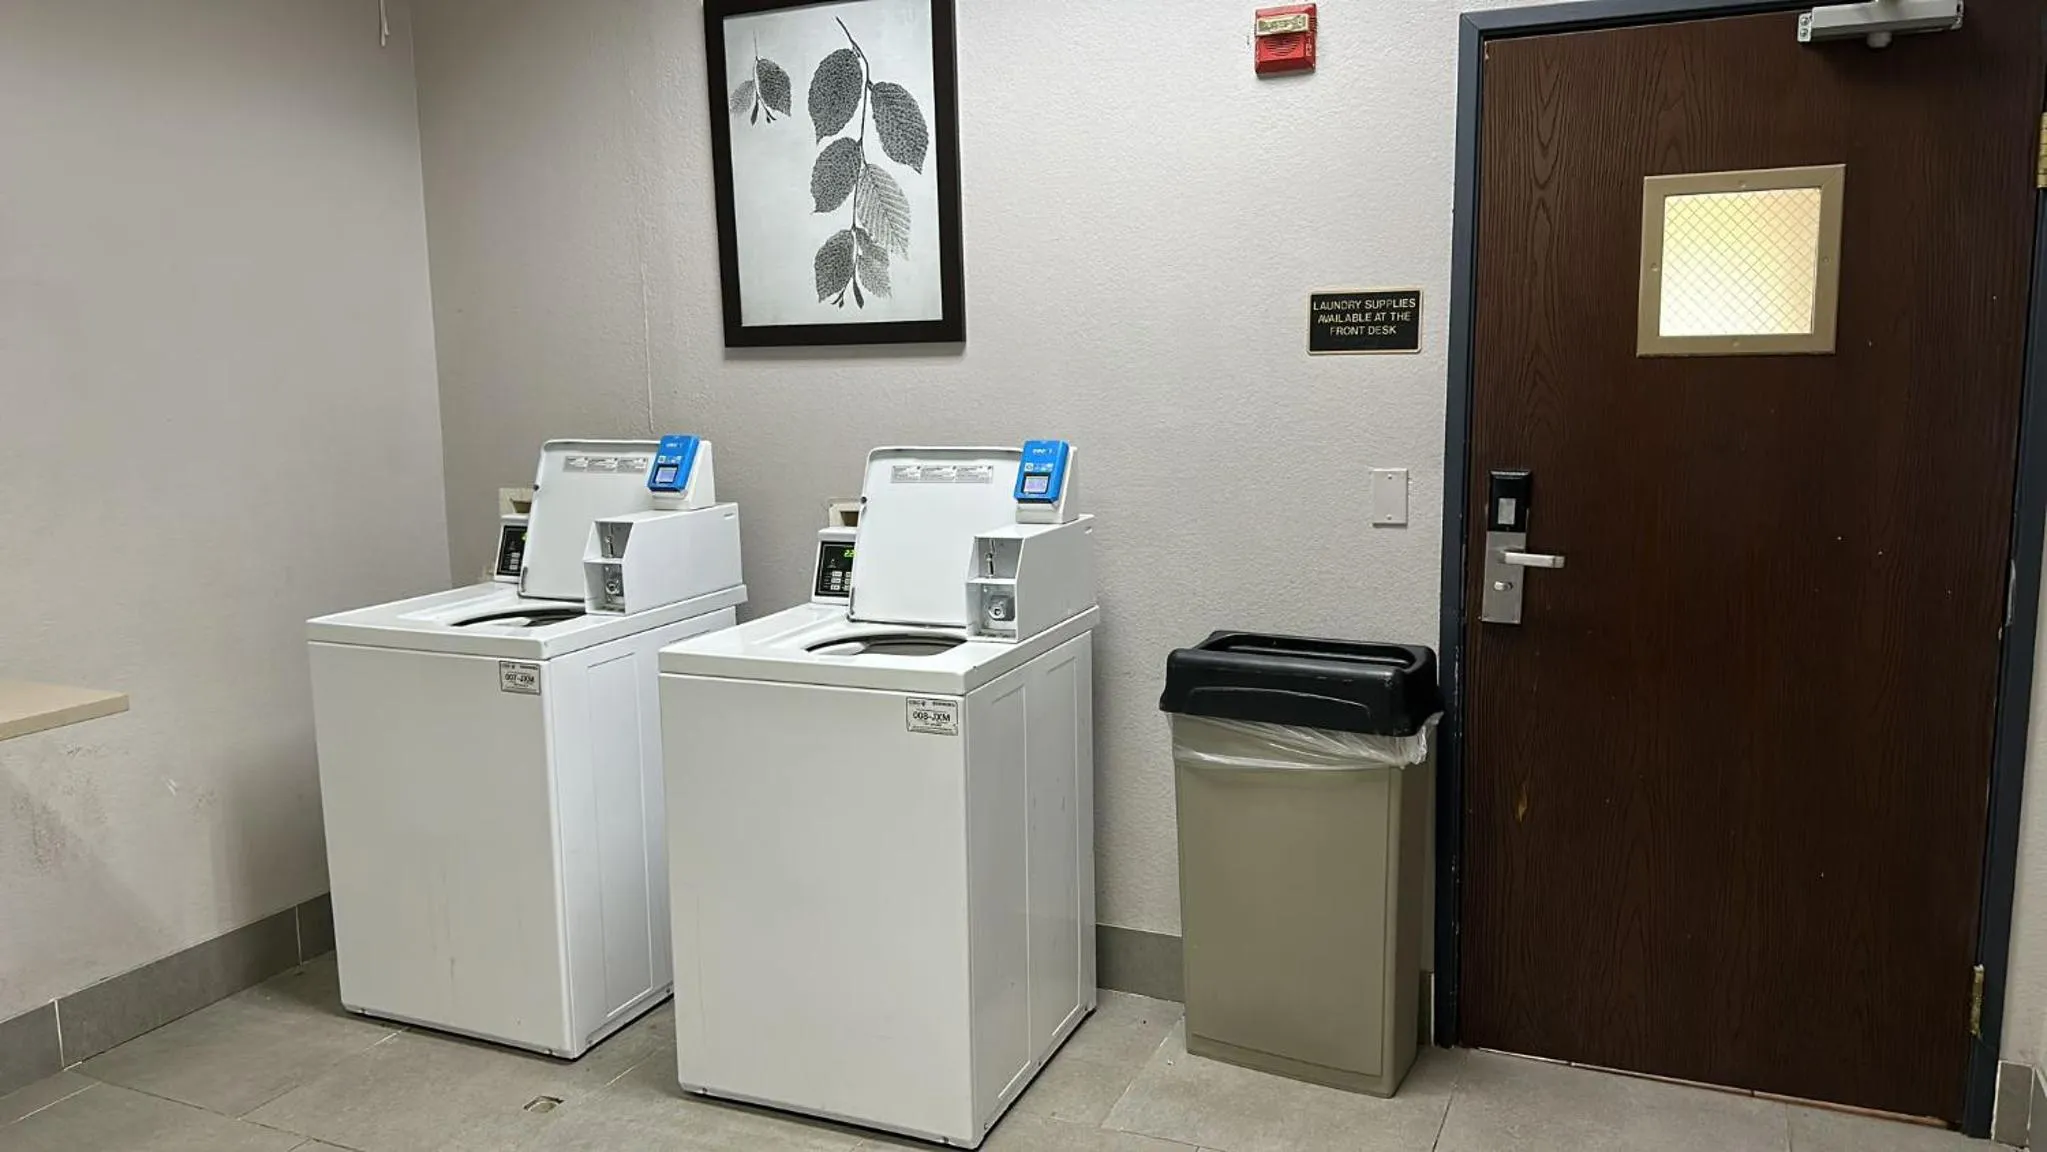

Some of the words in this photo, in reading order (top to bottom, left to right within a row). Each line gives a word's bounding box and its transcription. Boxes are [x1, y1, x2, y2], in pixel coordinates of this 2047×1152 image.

[1313, 300, 1361, 311] LAUNDRY
[1364, 298, 1416, 309] SUPPLIES
[1318, 312, 1372, 324] AVAILABLE
[1374, 312, 1387, 322] AT
[1390, 311, 1412, 322] THE
[1330, 325, 1365, 336] FRONT
[1367, 325, 1397, 335] DESK
